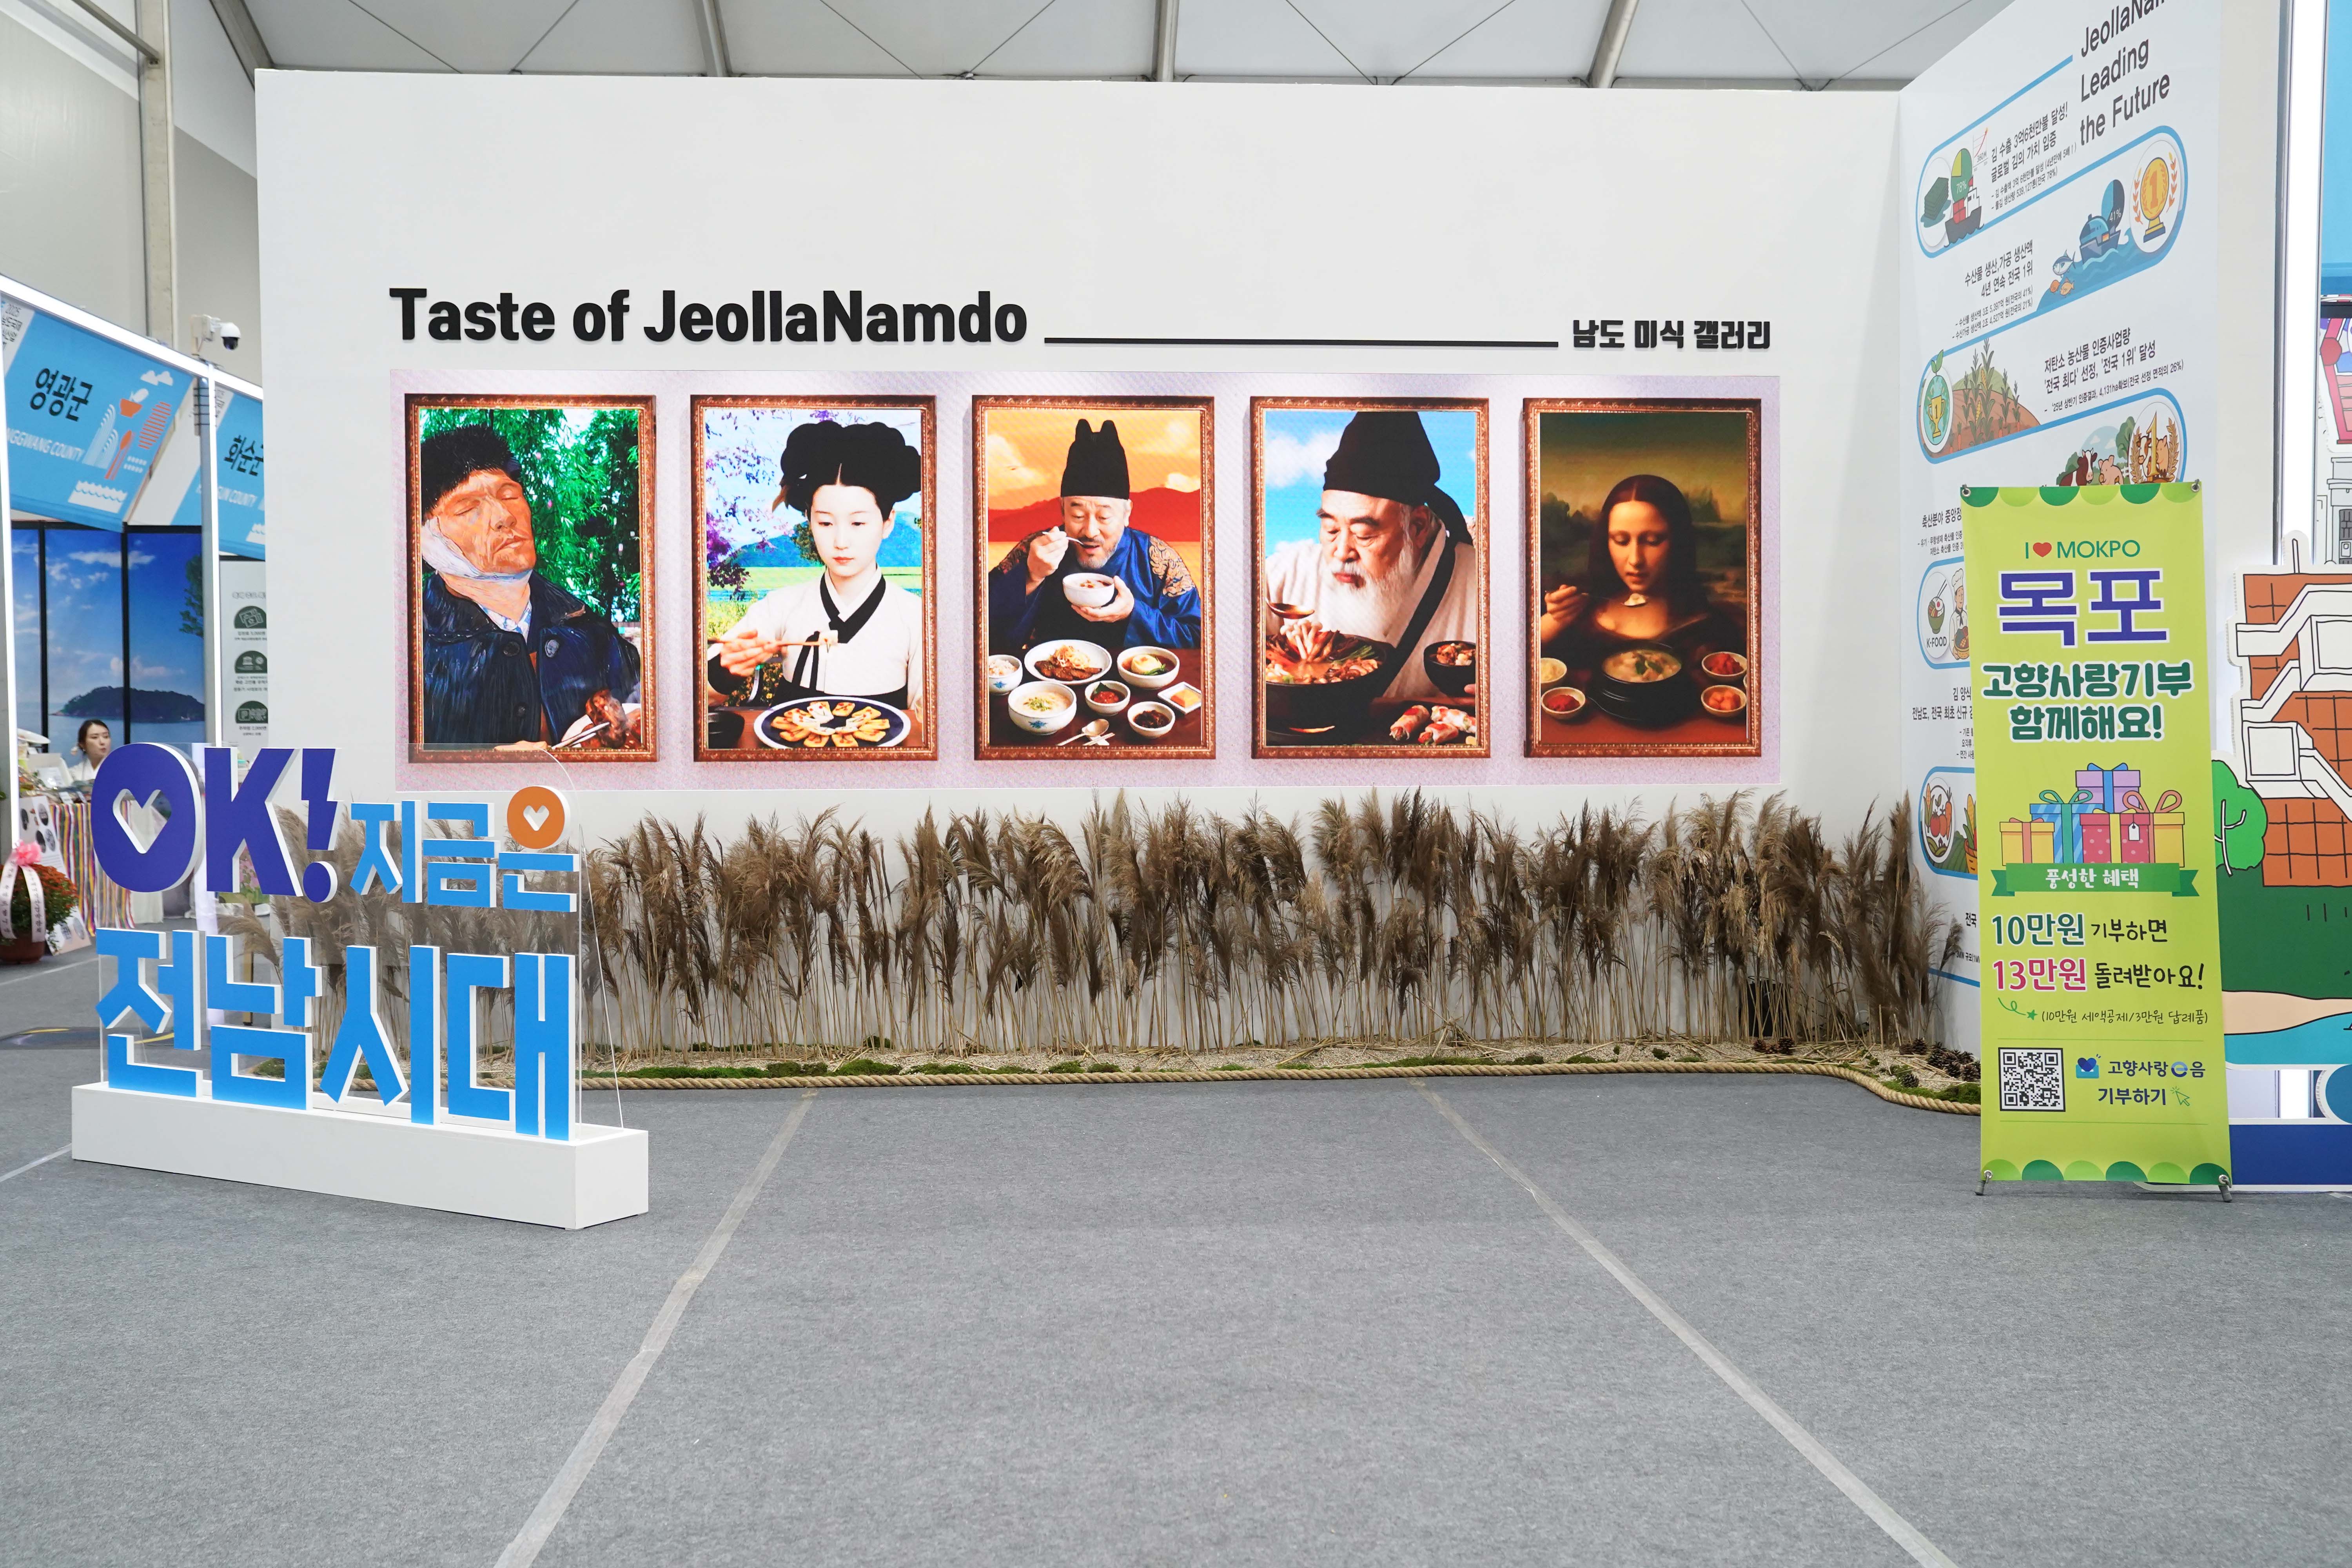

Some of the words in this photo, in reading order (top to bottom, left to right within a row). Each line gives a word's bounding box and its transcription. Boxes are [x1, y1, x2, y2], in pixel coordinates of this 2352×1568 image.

[2081, 0, 2164, 57] JeollaNa
[2081, 39, 2149, 103] Leading
[2080, 114, 2105, 146] the
[2113, 74, 2170, 128] Future
[1992, 146, 1997, 163] 김
[1999, 137, 2012, 157] 수출
[2014, 114, 2049, 148] 3억6천만불
[2051, 101, 2068, 126] 달성!
[1991, 159, 2009, 183] 글로벌
[2012, 149, 2024, 170] 김의
[2027, 140, 2040, 160] 가치
[2043, 130, 2056, 152] 입증
[1956, 180, 1967, 194] 78%
[2109, 208, 2122, 222] 41%
[1965, 266, 1983, 287] 수산물
[2014, 240, 2033, 262] 생산액
[1981, 281, 1991, 297] 4년
[1993, 274, 2005, 292] 연속
[2008, 267, 2020, 286] 전국
[2023, 260, 2033, 278] 1위
[2022, 297, 2033, 310] 21%)
[2023, 285, 2033, 297] 41%)
[390, 288, 555, 341] Taste
[572, 289, 630, 341] of
[644, 290, 1027, 342] JeollaNamdo
[1573, 320, 1624, 348] 남도
[1635, 320, 1684, 348] 미식
[1694, 321, 1770, 349] 갤러리
[2045, 354, 2065, 374] 저탄소
[2067, 343, 2089, 366] 농산물
[2092, 327, 2131, 357] 인증사업량
[2081, 362, 2098, 382] 선정,
[2139, 340, 2156, 361] 달성
[30, 367, 93, 422] 영광군
[2064, 396, 2077, 409] 상반기
[2141, 370, 2151, 383] 선정
[2153, 365, 2169, 379] 면적의
[2170, 359, 2184, 373] 26%)
[1922, 511, 1943, 528] 축산분야
[2025, 541, 2029, 559] I
[2057, 539, 2140, 558] MOKPO
[1998, 570, 2168, 647] 목포
[1927, 637, 1947, 648] K-FOOD
[1953, 687, 1958, 701] 김
[1960, 686, 1971, 701] 양식
[1982, 662, 2192, 697] 고향사랑기부
[1913, 706, 1929, 721] 전남도,
[1931, 706, 1942, 720] 전국
[1944, 706, 1955, 720] 최초
[1957, 705, 1967, 720] 신규
[2009, 704, 2162, 740] 함께해요!
[91, 742, 341, 902] OK!
[350, 786, 579, 912] 지금은
[2045, 868, 2097, 889] 풍성한
[2103, 868, 2139, 889] 혜택
[1965, 912, 1977, 928] 전국
[1992, 913, 2085, 946] 10만원
[2091, 919, 2168, 942] 기부하면
[1993, 958, 2087, 991] 13만원
[2094, 962, 2204, 989] 돌려받아요!
[96, 927, 576, 1141] 전남시대
[2041, 1010, 2077, 1022] (10만원
[2082, 1009, 2163, 1024] 세액공제/3만원
[2168, 1010, 2208, 1025] 답례품)
[2098, 1088, 2166, 1105] 기부하기
